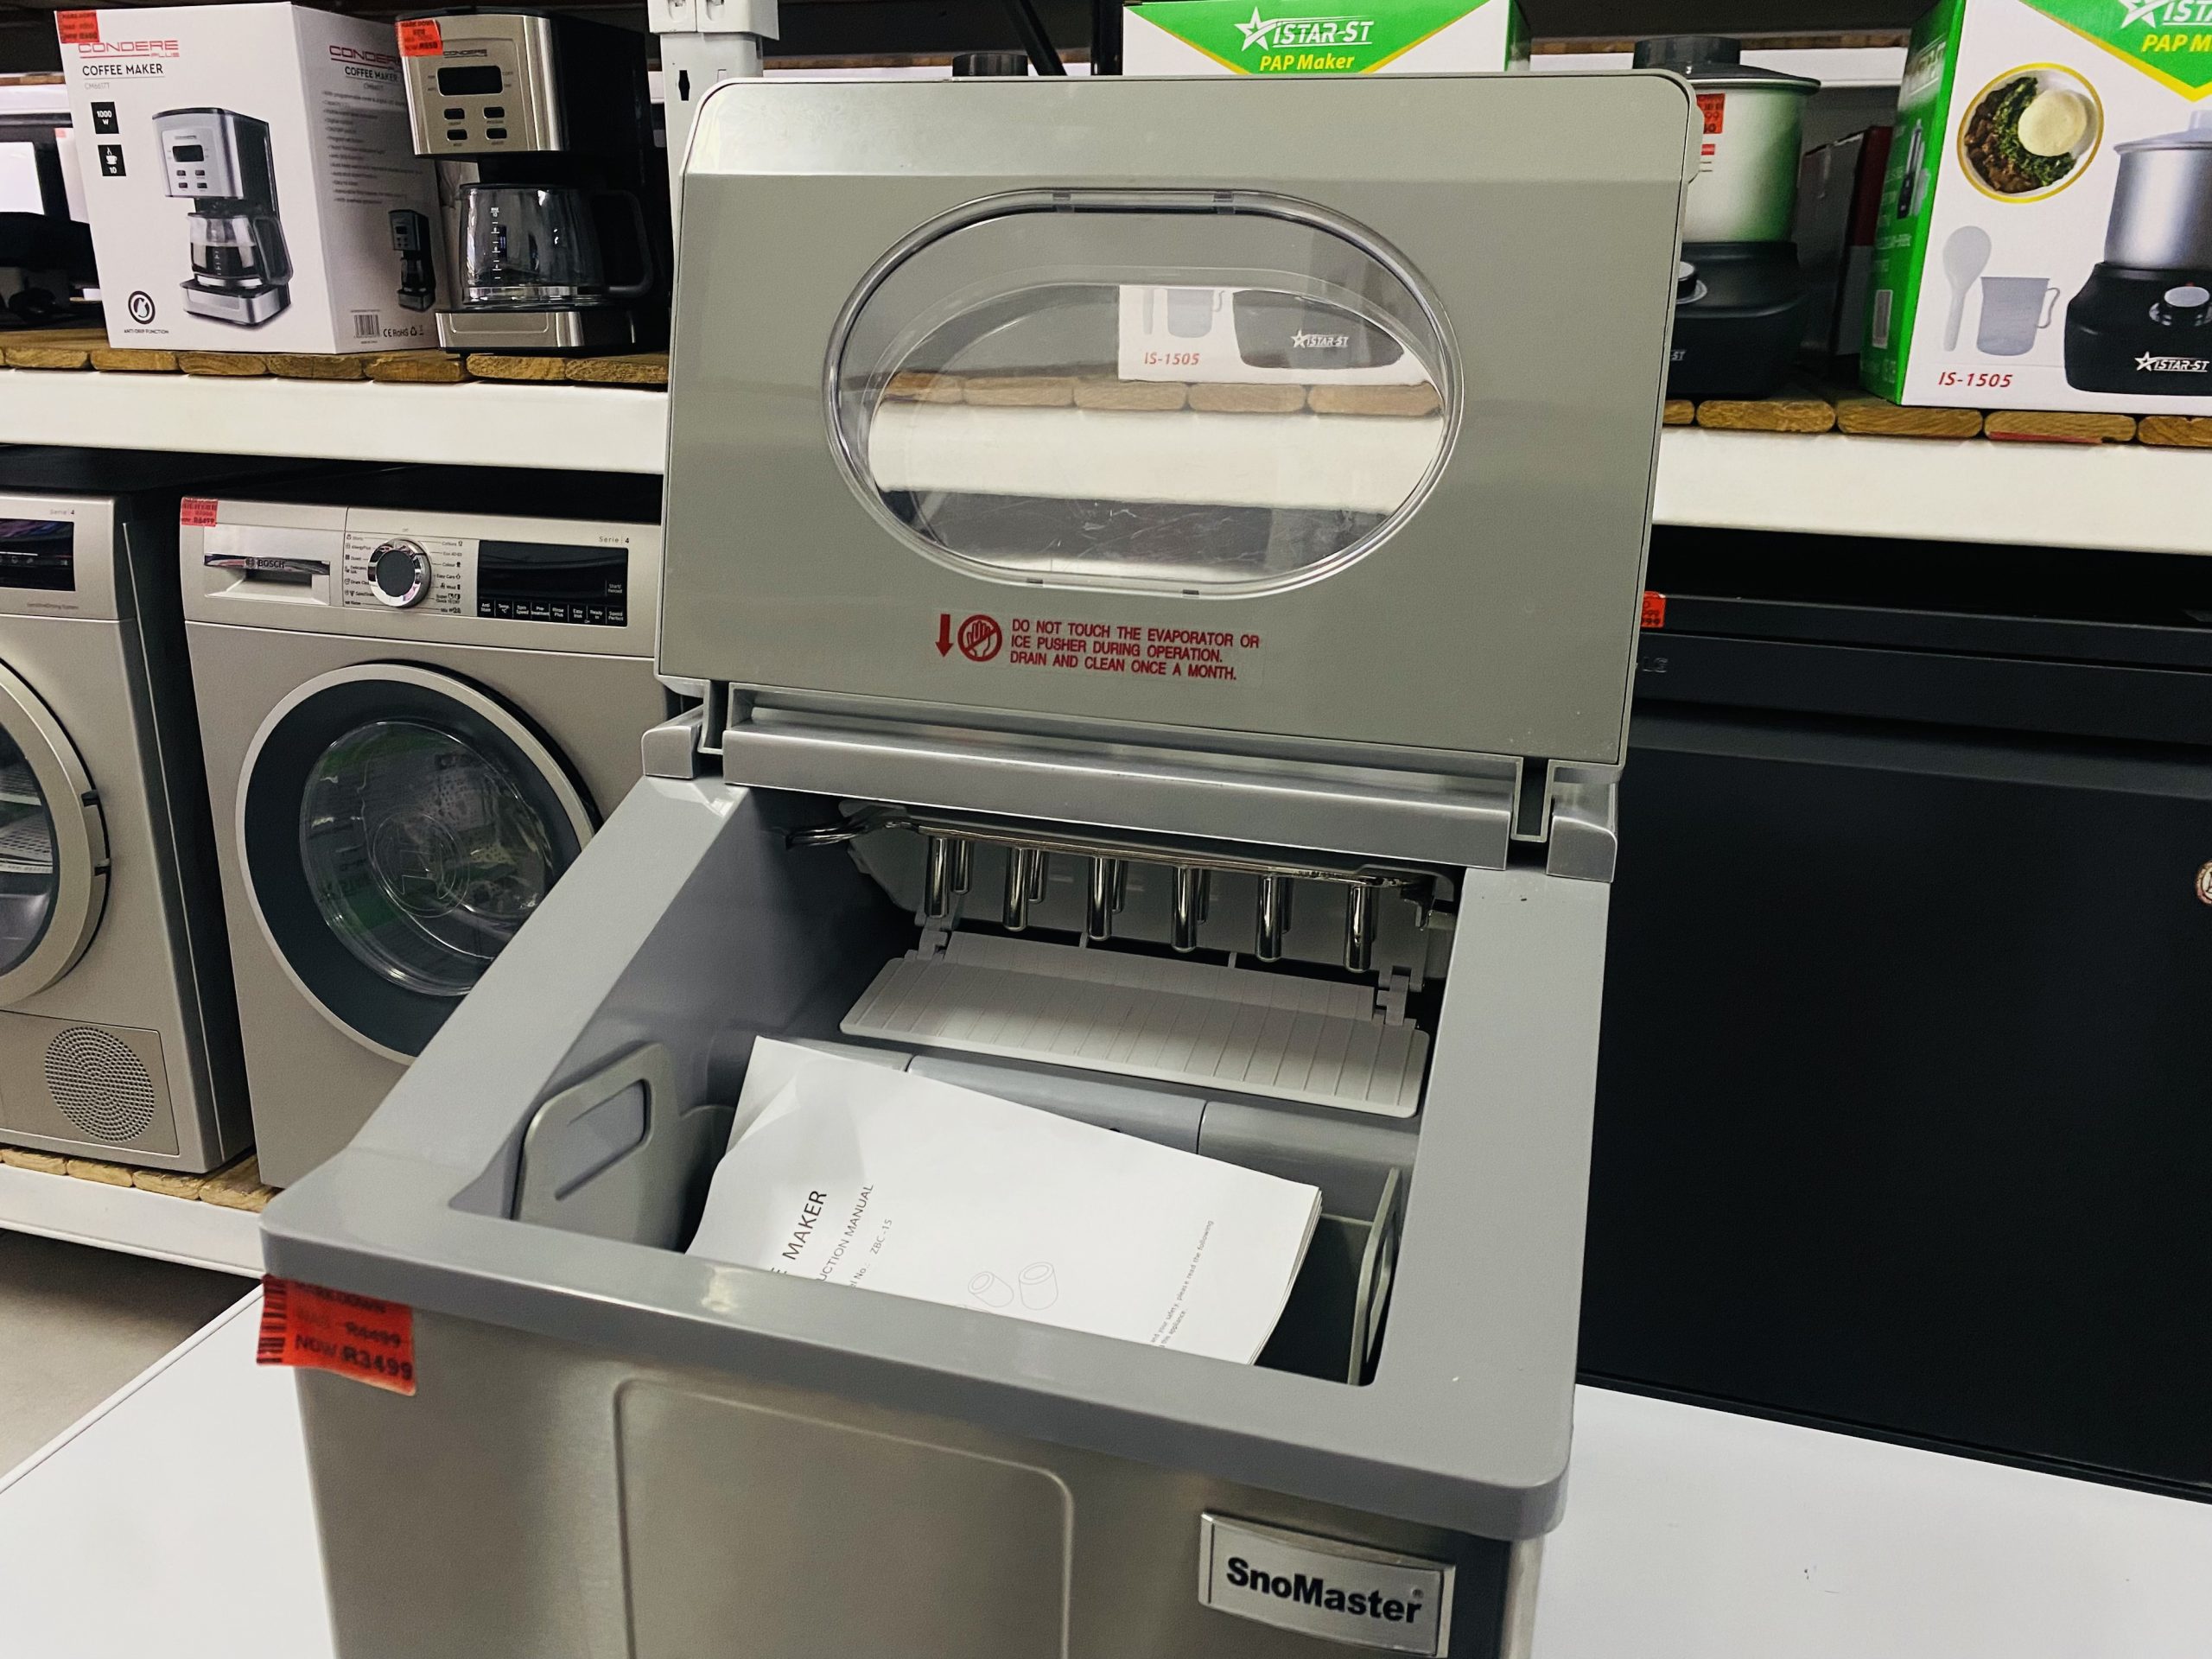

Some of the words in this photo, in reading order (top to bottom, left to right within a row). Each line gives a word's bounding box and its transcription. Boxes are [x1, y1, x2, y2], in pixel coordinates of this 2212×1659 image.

[78, 40, 179, 54] CONDERE
[2141, 33, 2189, 53] PAP
[329, 45, 402, 65] CONDER
[1260, 54, 1294, 72] PAP
[1297, 53, 1355, 70] Maker
[82, 64, 123, 76] COFFEE
[126, 63, 163, 75] MAKER
[345, 66, 373, 79] COFFEE
[375, 71, 399, 82] MAKER
[96, 110, 112, 118] 1000
[1144, 352, 1200, 366] IS-1505
[1937, 371, 2014, 388] IS-1505
[257, 559, 284, 569] BOSCH
[1012, 618, 1030, 632] DO
[1037, 620, 1062, 635] NOT
[1068, 622, 1111, 639] TOUCH
[1117, 626, 1141, 641] THE
[1148, 628, 1233, 647] EVAPORATOR
[1240, 634, 1260, 649] OR
[1011, 634, 1031, 649] ICE
[1038, 637, 1087, 653] PUSHER
[1093, 640, 1141, 658] DURING
[1147, 645, 1224, 664] OPERATION.
[1010, 650, 1047, 666] DRAIN
[1052, 653, 1078, 669] AND
[1084, 656, 1125, 672] CLEAN
[1131, 659, 1166, 676] ONCE
[1172, 663, 1182, 677] A
[1187, 664, 1237, 682] MONTH.
[782, 1190, 827, 1261] MAKER
[816, 1238, 850, 1282] UCTION
[844, 1183, 874, 1236] MANUAL
[1186, 1264, 1197, 1280] read
[1192, 1252, 1201, 1263] the
[1197, 1220, 1215, 1251] following
[342, 1344, 413, 1381] R3499
[1226, 1556, 1423, 1624] SnoMaster
